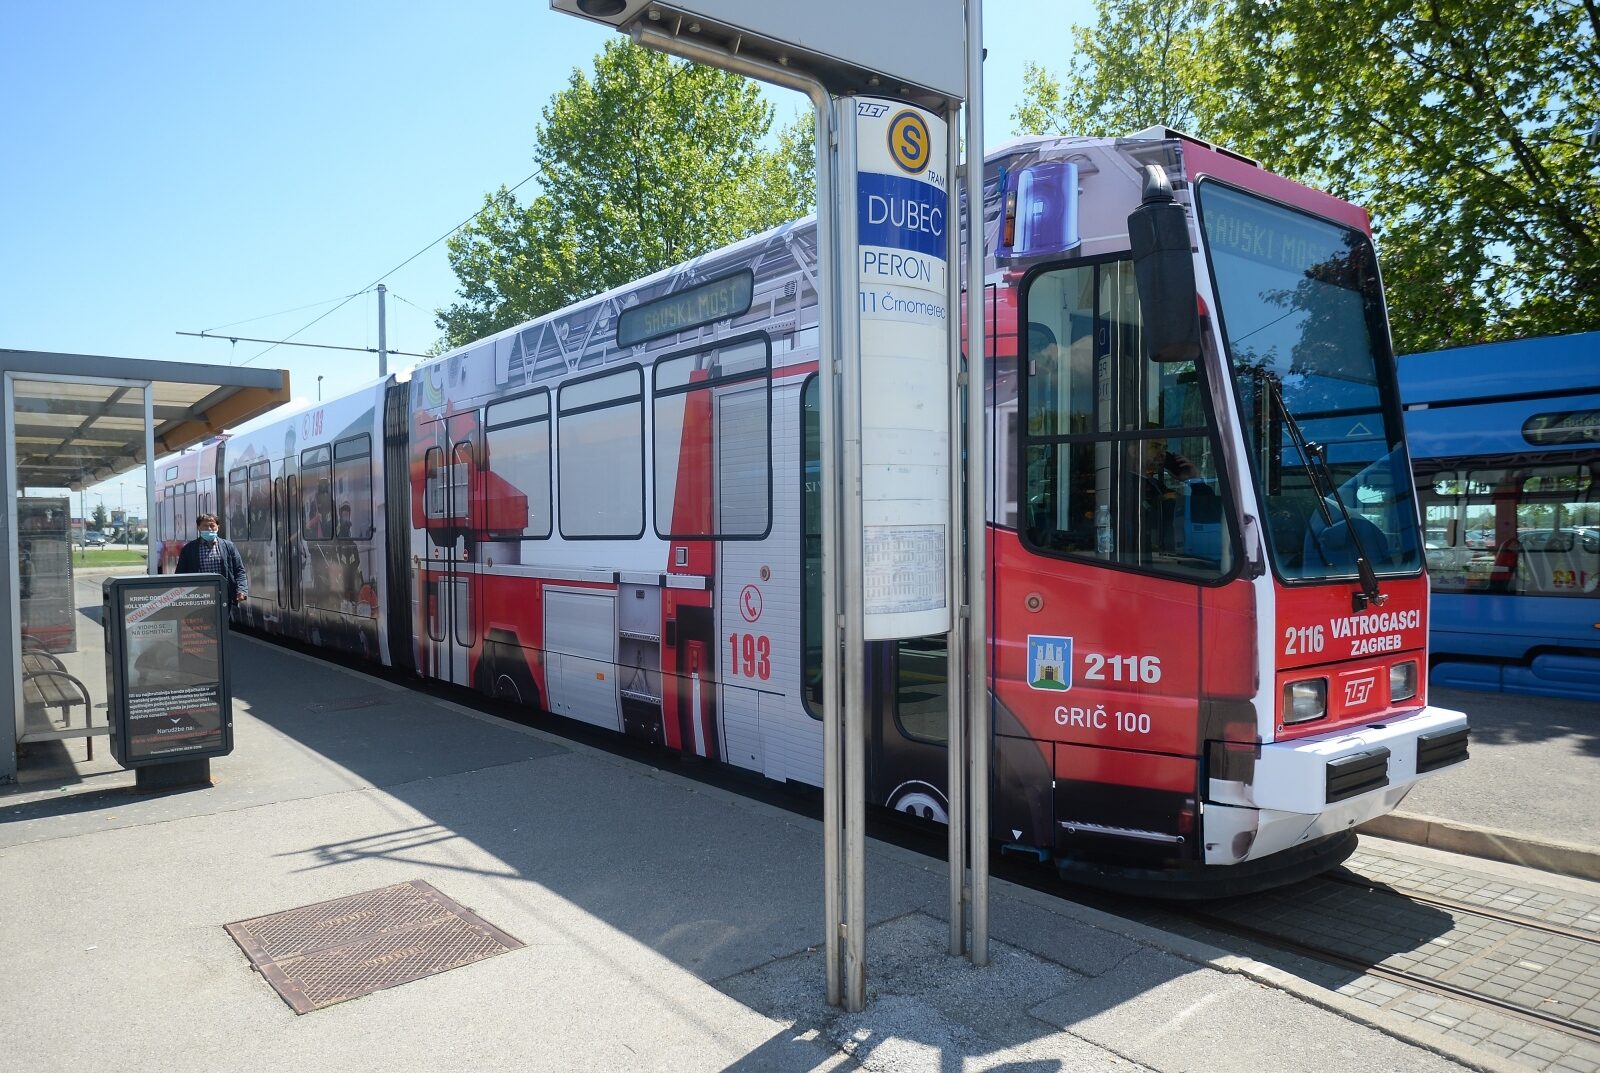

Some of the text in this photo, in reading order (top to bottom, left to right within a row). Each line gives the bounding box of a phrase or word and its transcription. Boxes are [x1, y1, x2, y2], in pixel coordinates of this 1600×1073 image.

[858, 103, 889, 118] ZET
[901, 124, 921, 160] S
[928, 170, 945, 187] TRAM
[868, 195, 942, 237] DUBEC
[864, 251, 931, 283] PERON
[644, 285, 737, 334] SAVSKI MOST
[860, 291, 946, 320] 11 Črnomerec
[1535, 417, 1547, 441] 7
[1330, 609, 1421, 639] VATROGASCI
[1284, 624, 1325, 655] 2116
[1350, 634, 1402, 656] ZAGREB
[729, 633, 771, 681] 193
[1084, 653, 1162, 684] 2116
[1344, 676, 1375, 707] ZET
[157, 726, 185, 735] Narudžbe
[1054, 704, 1151, 734] GRIČ 100
